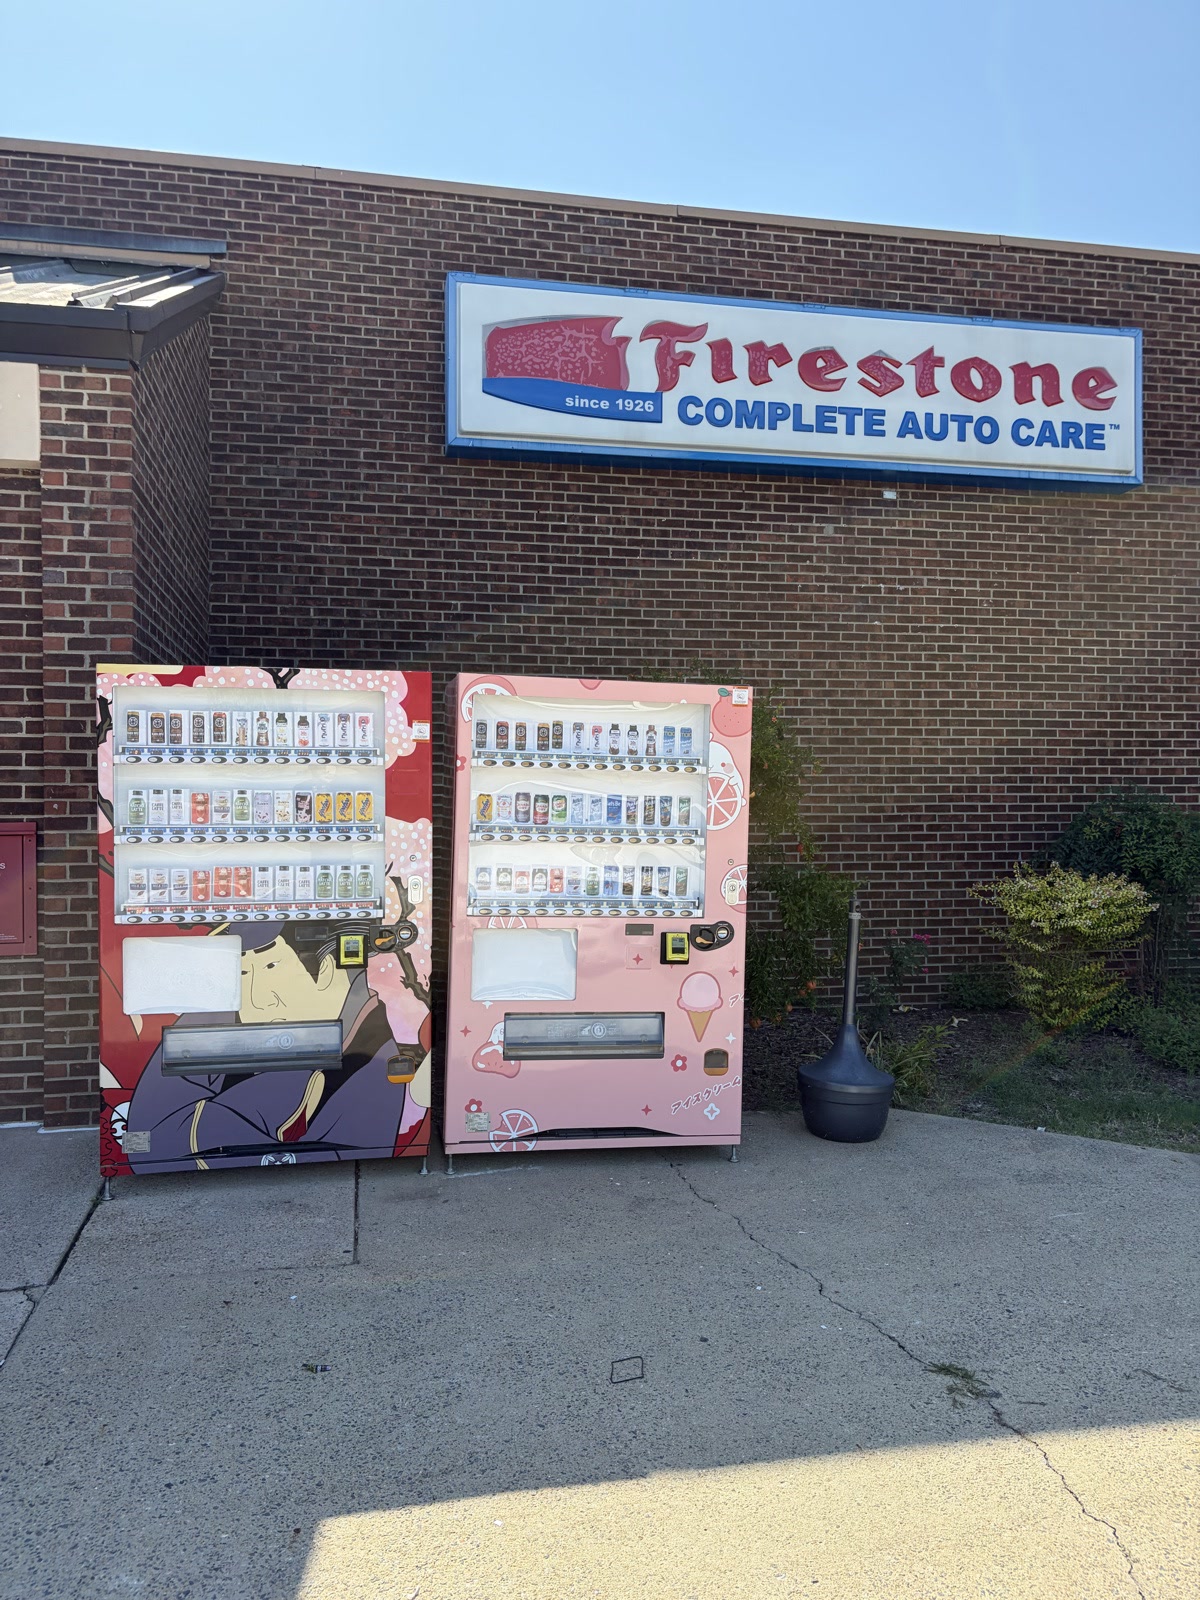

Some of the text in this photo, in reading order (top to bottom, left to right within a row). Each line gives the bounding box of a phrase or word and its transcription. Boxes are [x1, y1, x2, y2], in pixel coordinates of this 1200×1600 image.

[640, 319, 1118, 411] Firestone
[565, 395, 655, 412] since 1926
[677, 395, 886, 437] COMPLETE
[897, 411, 1000, 445] AUTO
[671, 1076, 741, 1114] アイスクリーム
